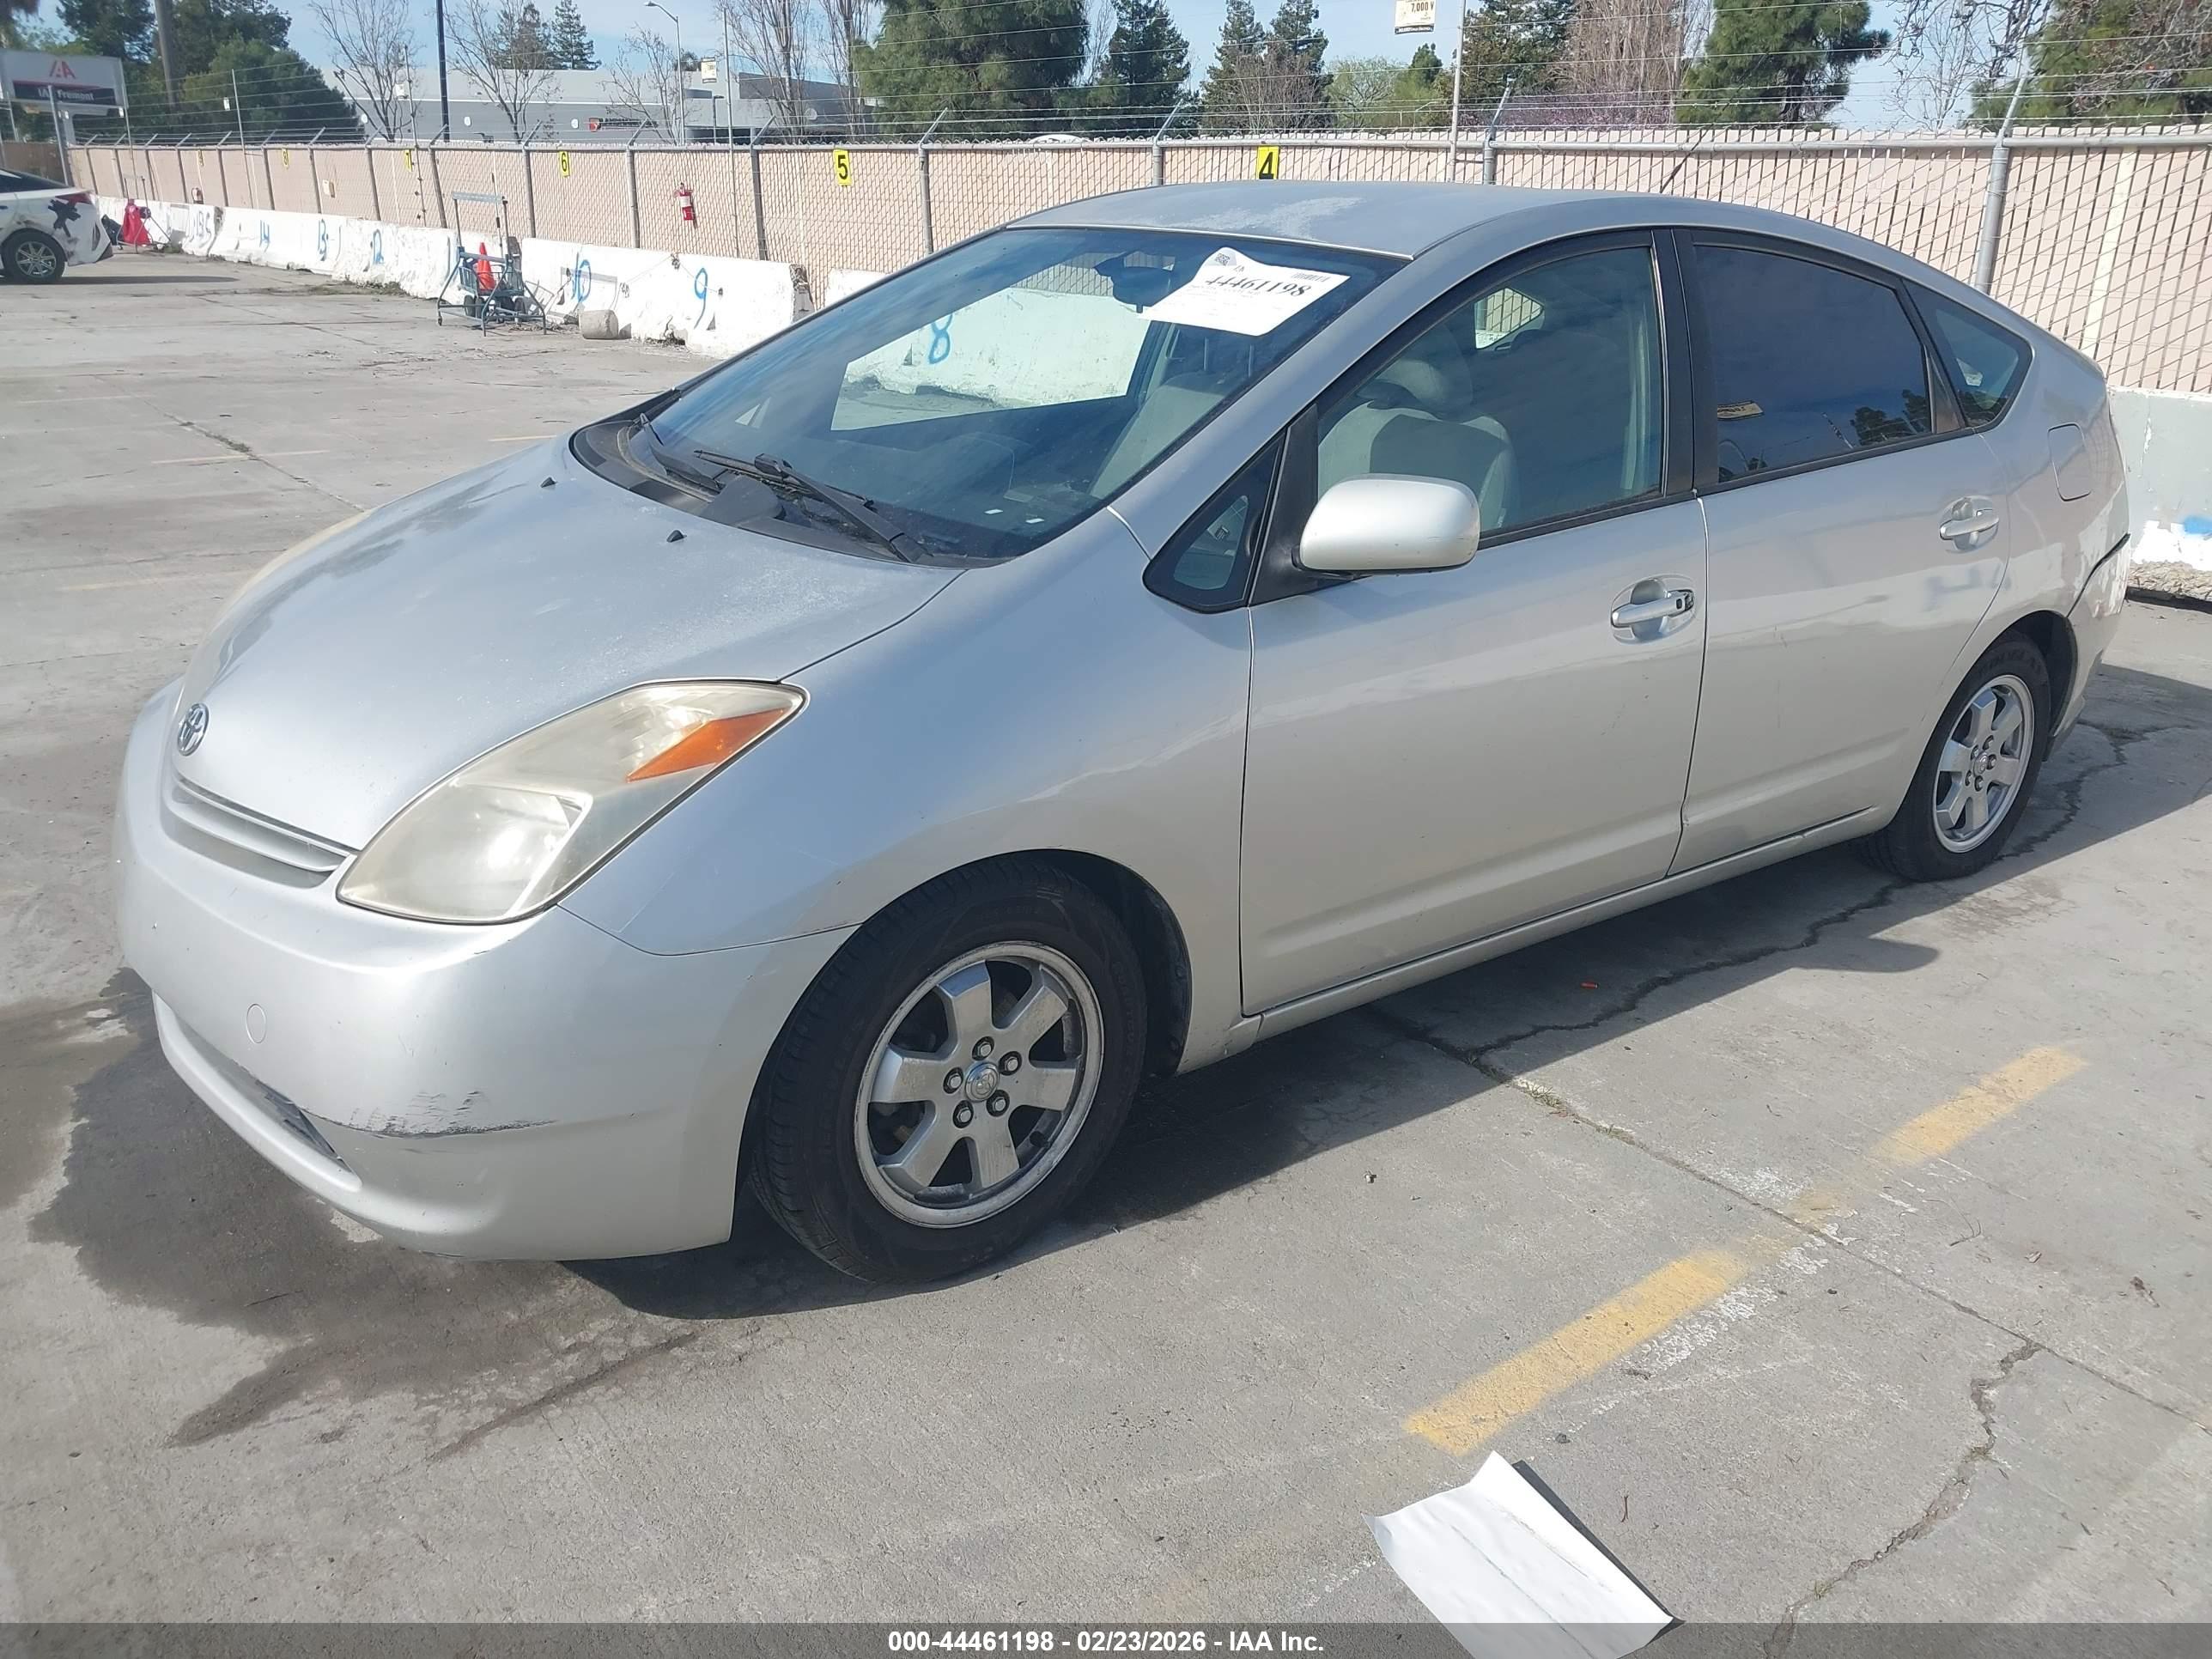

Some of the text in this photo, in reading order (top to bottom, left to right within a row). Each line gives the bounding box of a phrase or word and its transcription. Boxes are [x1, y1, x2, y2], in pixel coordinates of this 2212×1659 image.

[57, 89, 94, 100] Fremont
[562, 152, 568, 173] 6
[838, 155, 848, 180] 5
[1259, 151, 1274, 179] 4
[694, 267, 708, 330] 9
[1205, 276, 1312, 296] 44461198
[928, 313, 953, 364] 8
